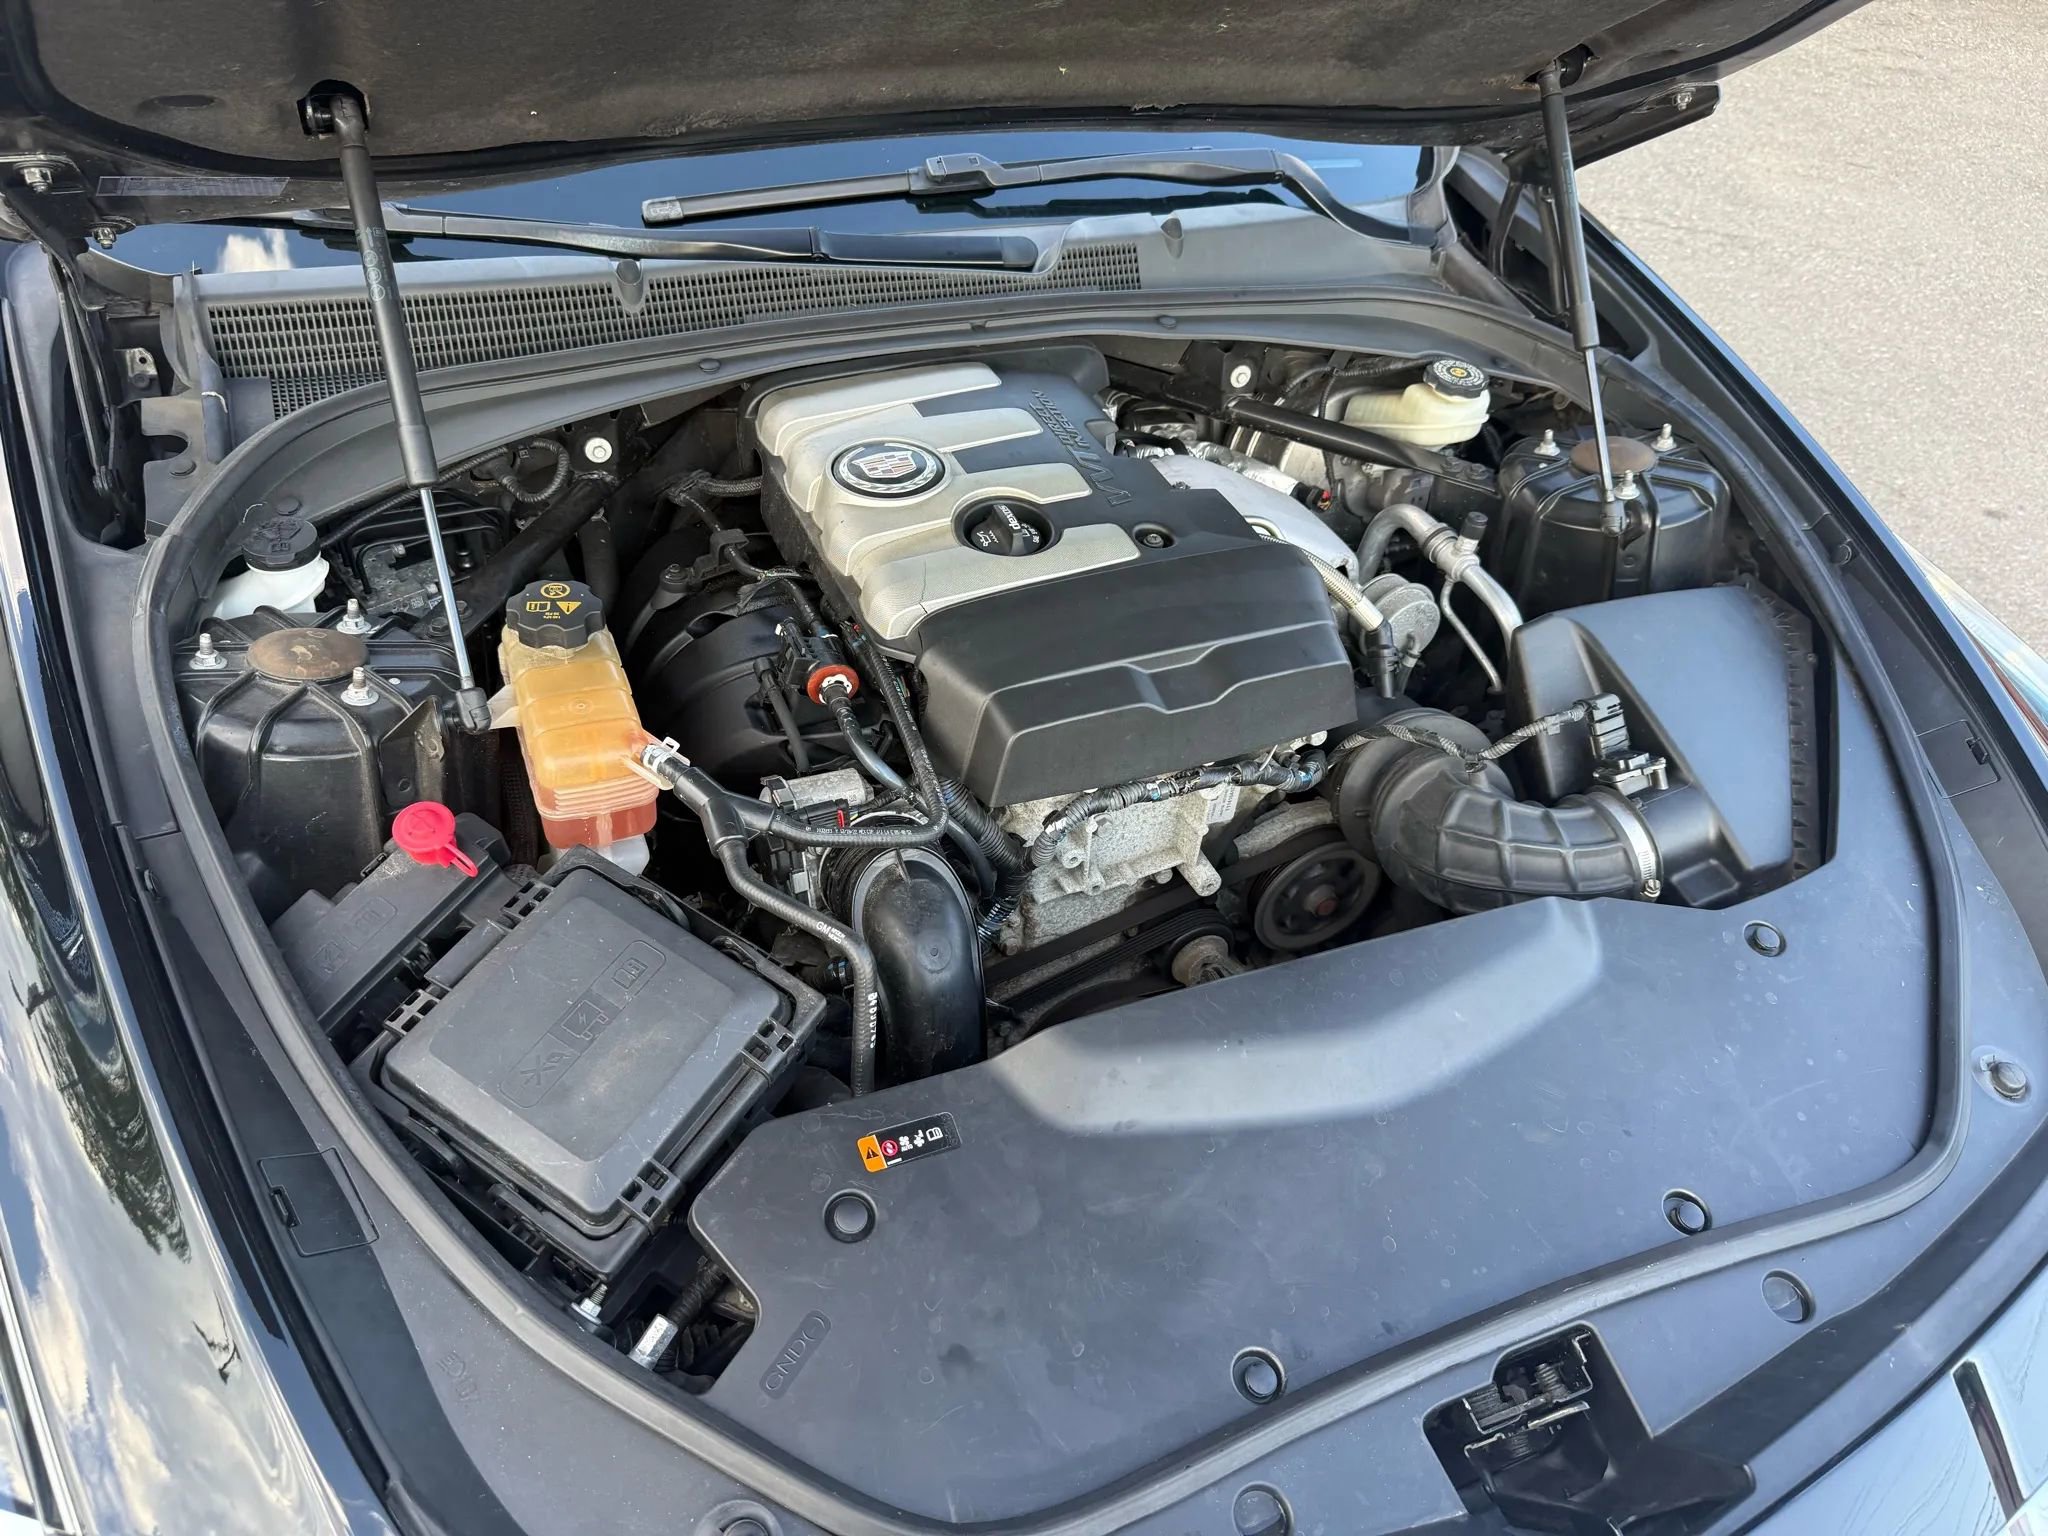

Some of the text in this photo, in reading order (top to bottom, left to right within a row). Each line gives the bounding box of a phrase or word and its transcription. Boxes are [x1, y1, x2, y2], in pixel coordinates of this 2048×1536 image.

[1028, 401, 1076, 448] DIRECT
[1031, 389, 1090, 450] INJECTION
[1070, 449, 1133, 508] VVT
[998, 504, 1022, 530] dexos
